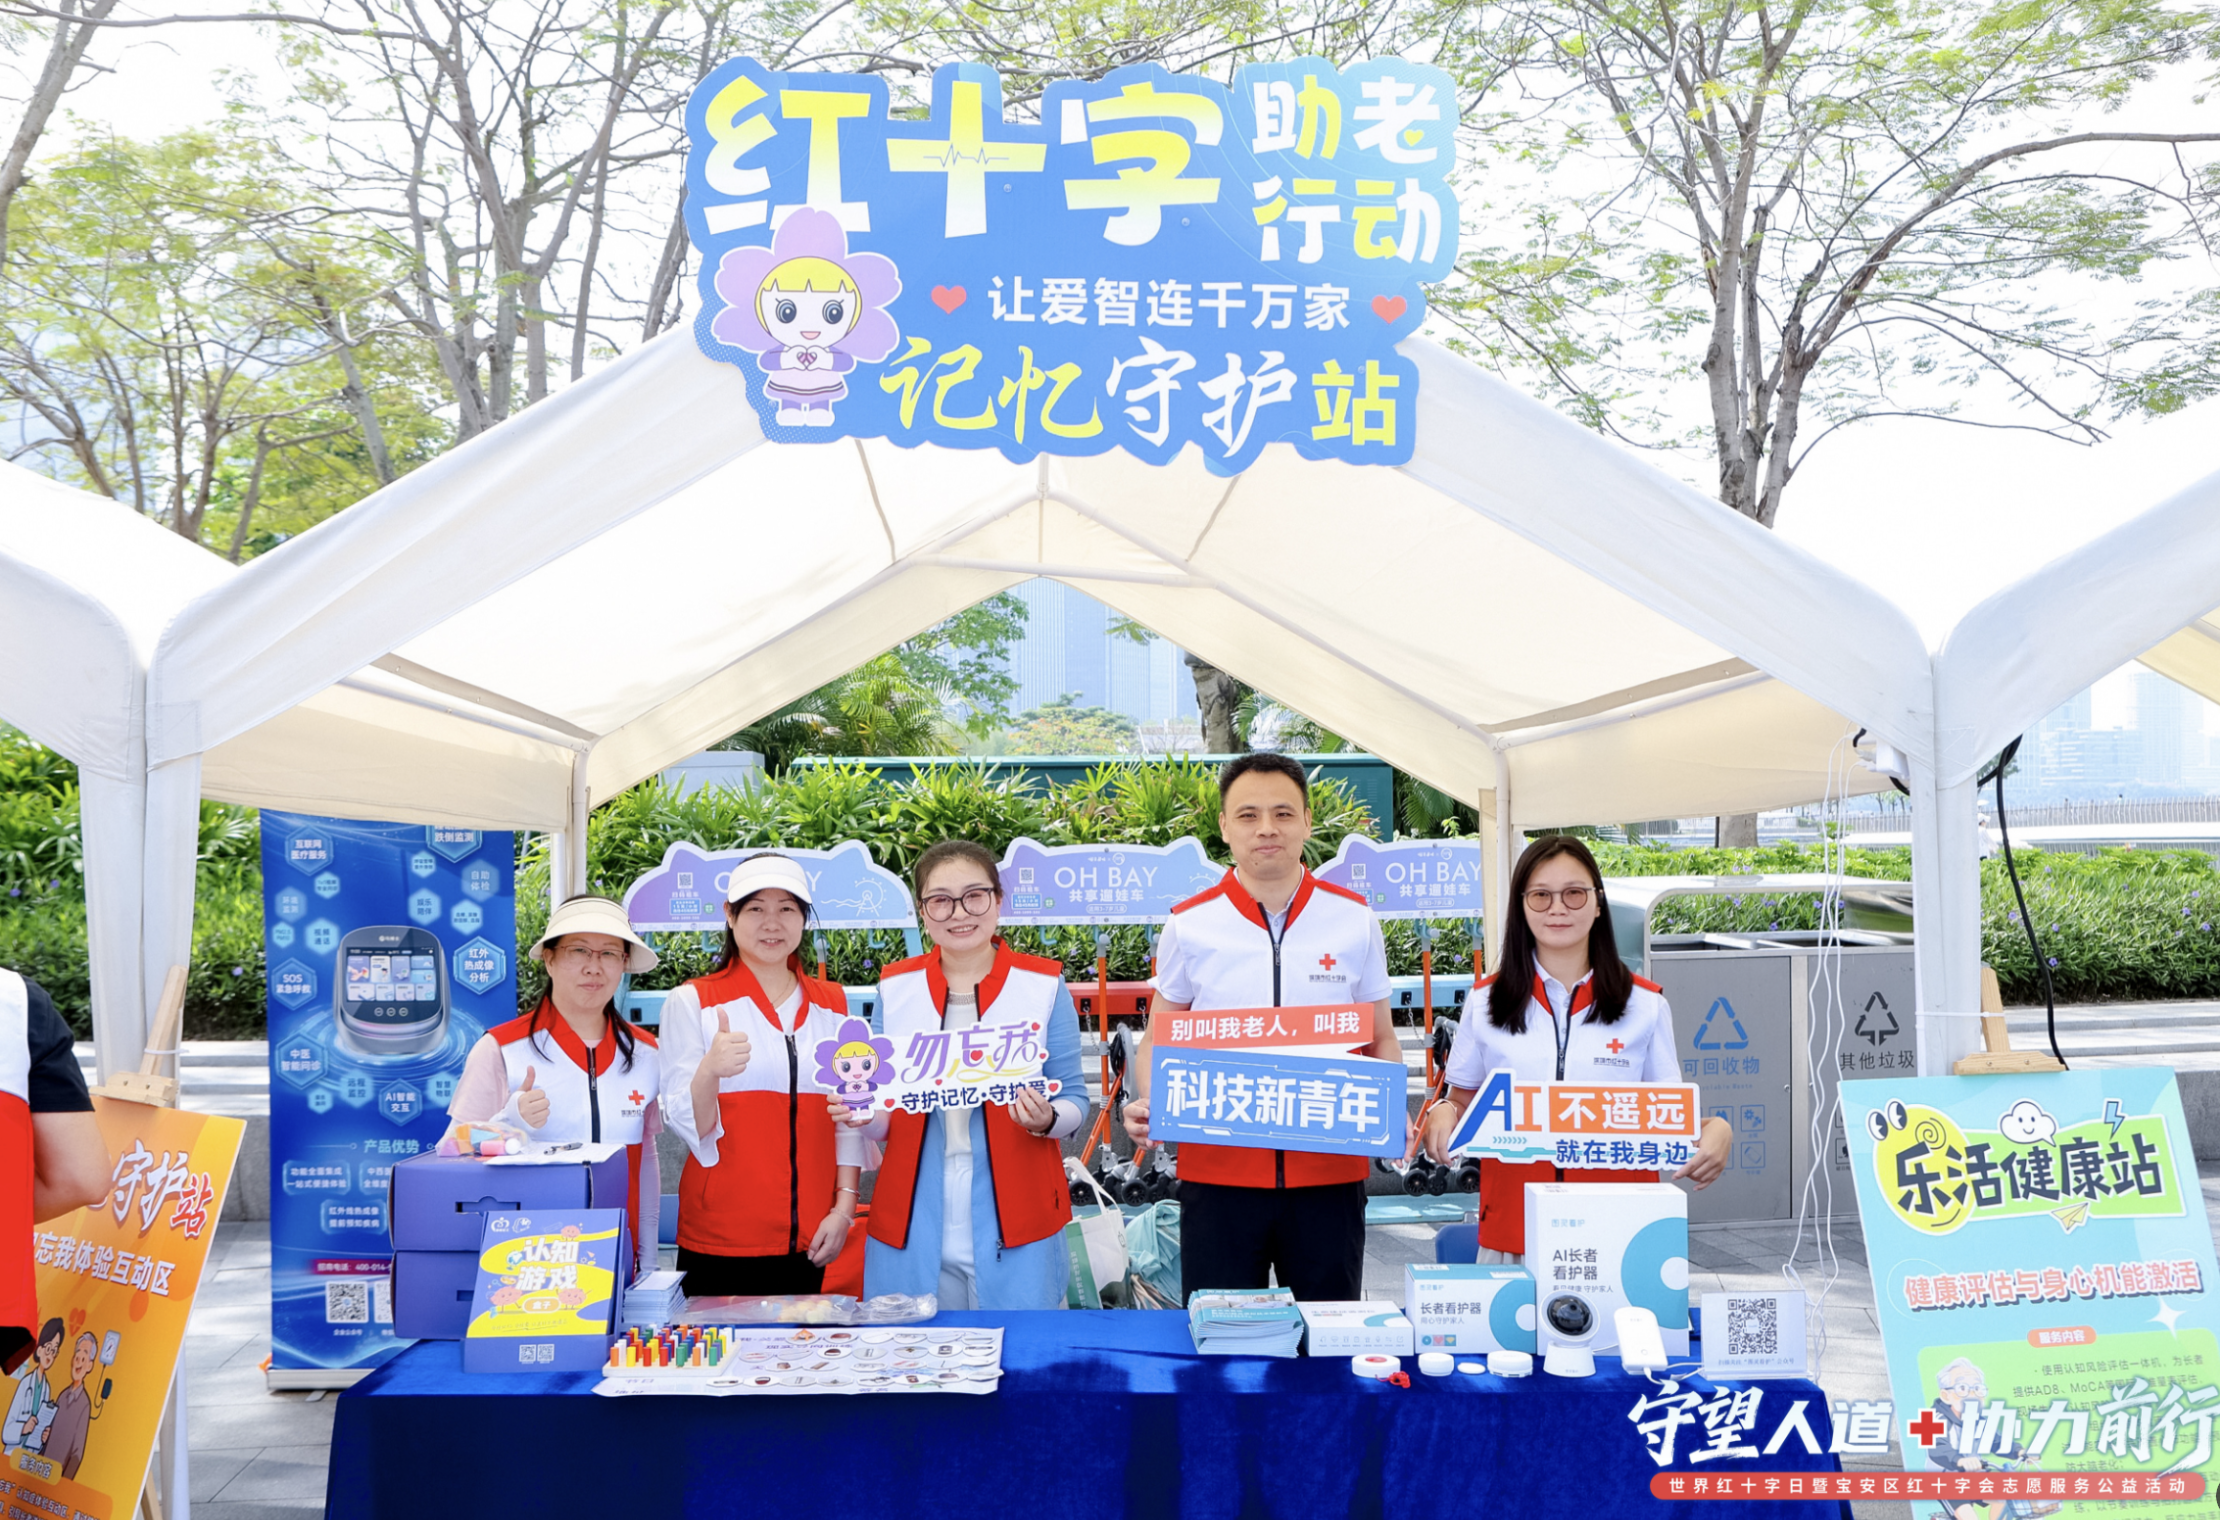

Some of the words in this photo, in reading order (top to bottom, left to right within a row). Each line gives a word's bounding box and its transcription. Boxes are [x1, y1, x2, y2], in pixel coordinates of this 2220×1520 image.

[1252, 74, 1442, 165] 助老
[703, 74, 1225, 246] 红十字
[1252, 174, 1442, 264] 行动
[988, 275, 1351, 330] 让爱智连千万家
[879, 334, 1400, 456] 记忆守护站
[471, 870, 490, 880] 自助
[1054, 866, 1097, 889] OH
[1108, 866, 1158, 888] BAY
[1385, 862, 1426, 884] OH
[1437, 861, 1481, 882] BAY
[1069, 889, 1144, 903] 共享遛娃车
[1399, 883, 1471, 898] 共享遛娃车
[468, 947, 489, 958] 红外
[463, 959, 495, 971] 热成像
[282, 974, 303, 983] SOS
[468, 972, 490, 983] 分析
[1171, 1011, 1360, 1042] 别叫我老人，叫我
[290, 1049, 311, 1059] 中医
[901, 1020, 1039, 1085] 勿忘我
[1840, 1050, 1914, 1071] 其他垃圾
[1682, 1055, 1760, 1077] 可回收物
[385, 1092, 416, 1102] AI智能
[1165, 1068, 1381, 1133] 科技新青年
[391, 1103, 410, 1113] 交互
[363, 1139, 420, 1154] 产品优势
[1555, 1139, 1689, 1165] 就在我身边
[1896, 1132, 2163, 1215] 乐活健康站
[88, 1138, 214, 1240] 守护站
[522, 1237, 580, 1263] 认知
[1552, 1248, 1598, 1263] AI长者
[515, 1264, 577, 1291] 游戏
[1553, 1265, 1598, 1281] 看护器
[1584, 1285, 1614, 1293] 守护家人
[1904, 1260, 2204, 1313] 健康评估与身心机能激活
[531, 1301, 551, 1310] 盒子
[1420, 1302, 1482, 1315] 长者看护器
[1420, 1316, 1465, 1325] 用心守护家人
[2039, 1328, 2086, 1345] 服务内容
[19, 1453, 53, 1479] 服务内容
